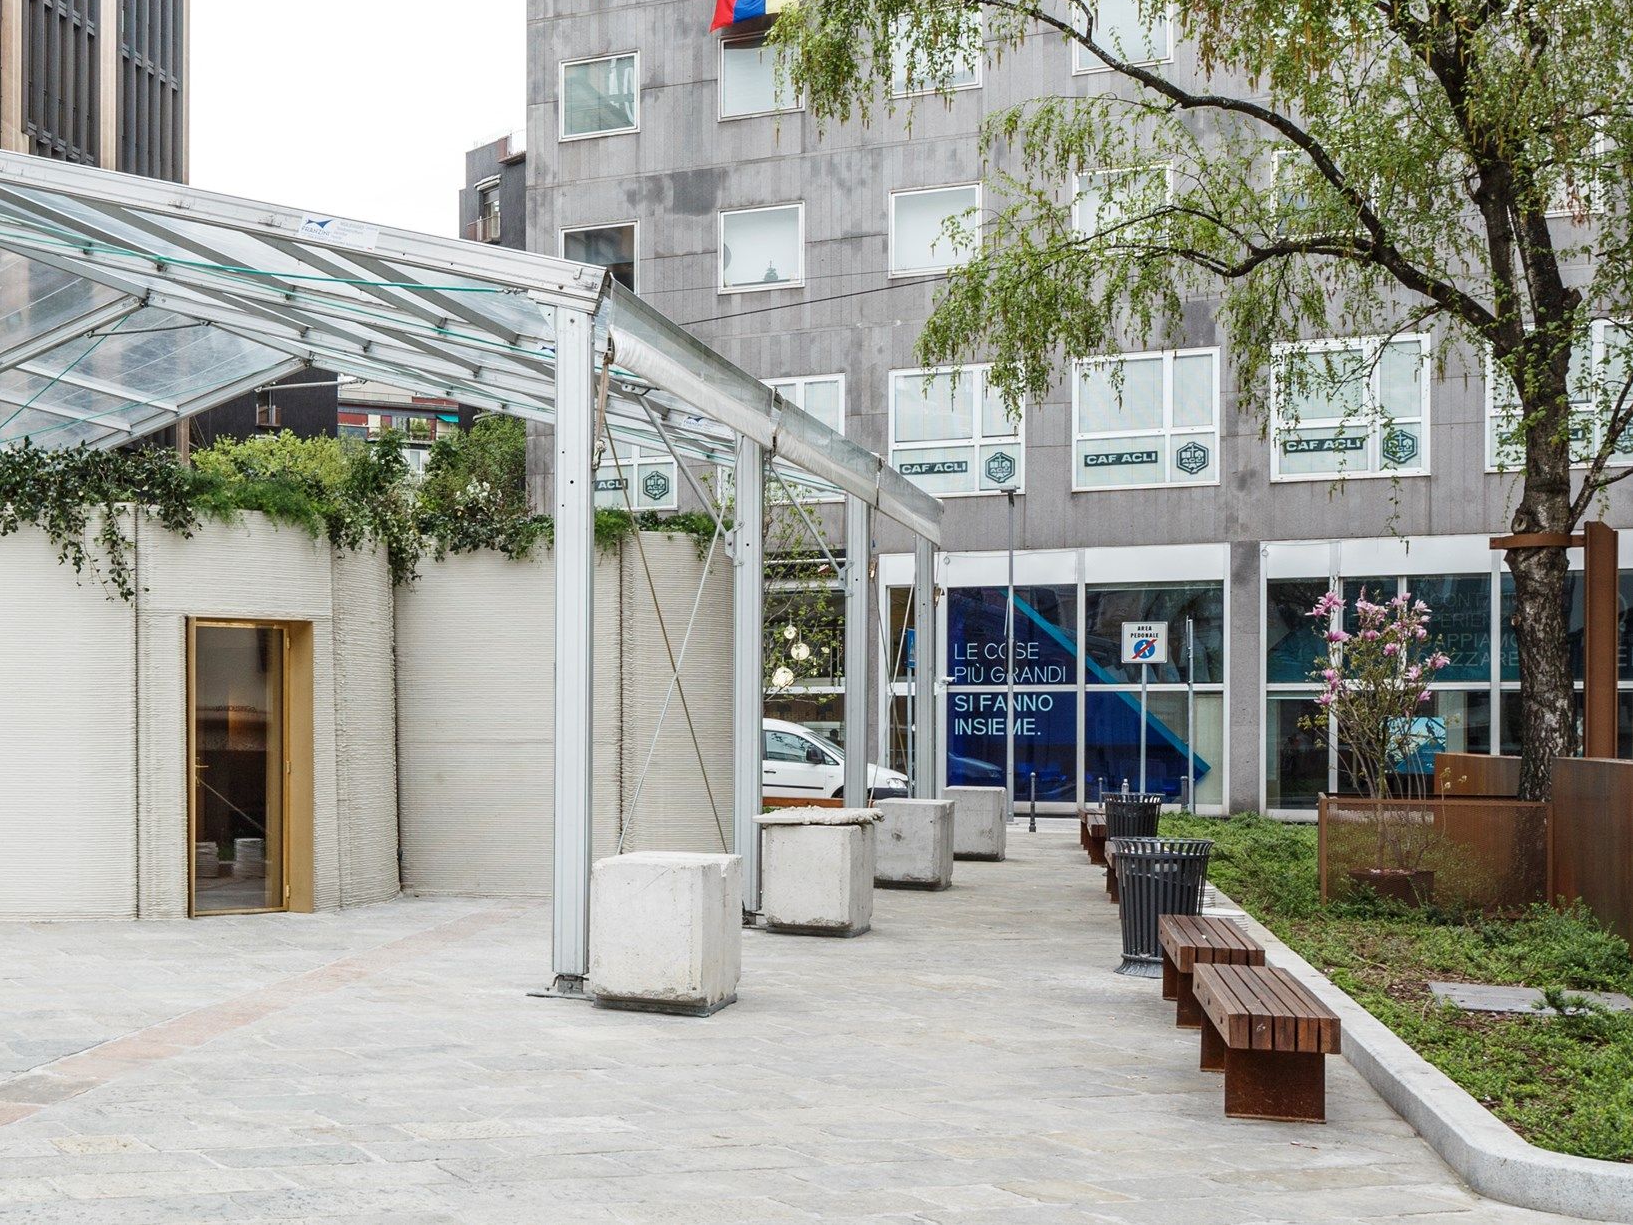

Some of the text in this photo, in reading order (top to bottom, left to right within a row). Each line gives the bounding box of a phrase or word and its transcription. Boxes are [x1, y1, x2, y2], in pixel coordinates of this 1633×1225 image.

[1286, 439, 1361, 451] CAF ACLI
[1086, 452, 1156, 465] CAF ACLI
[901, 462, 966, 474] CAF ACLI
[954, 642, 978, 660] LE
[954, 663, 1066, 683] PIÙ GRANDI
[954, 694, 1054, 712] SI FANNO
[954, 718, 1042, 736] INSIEME.
